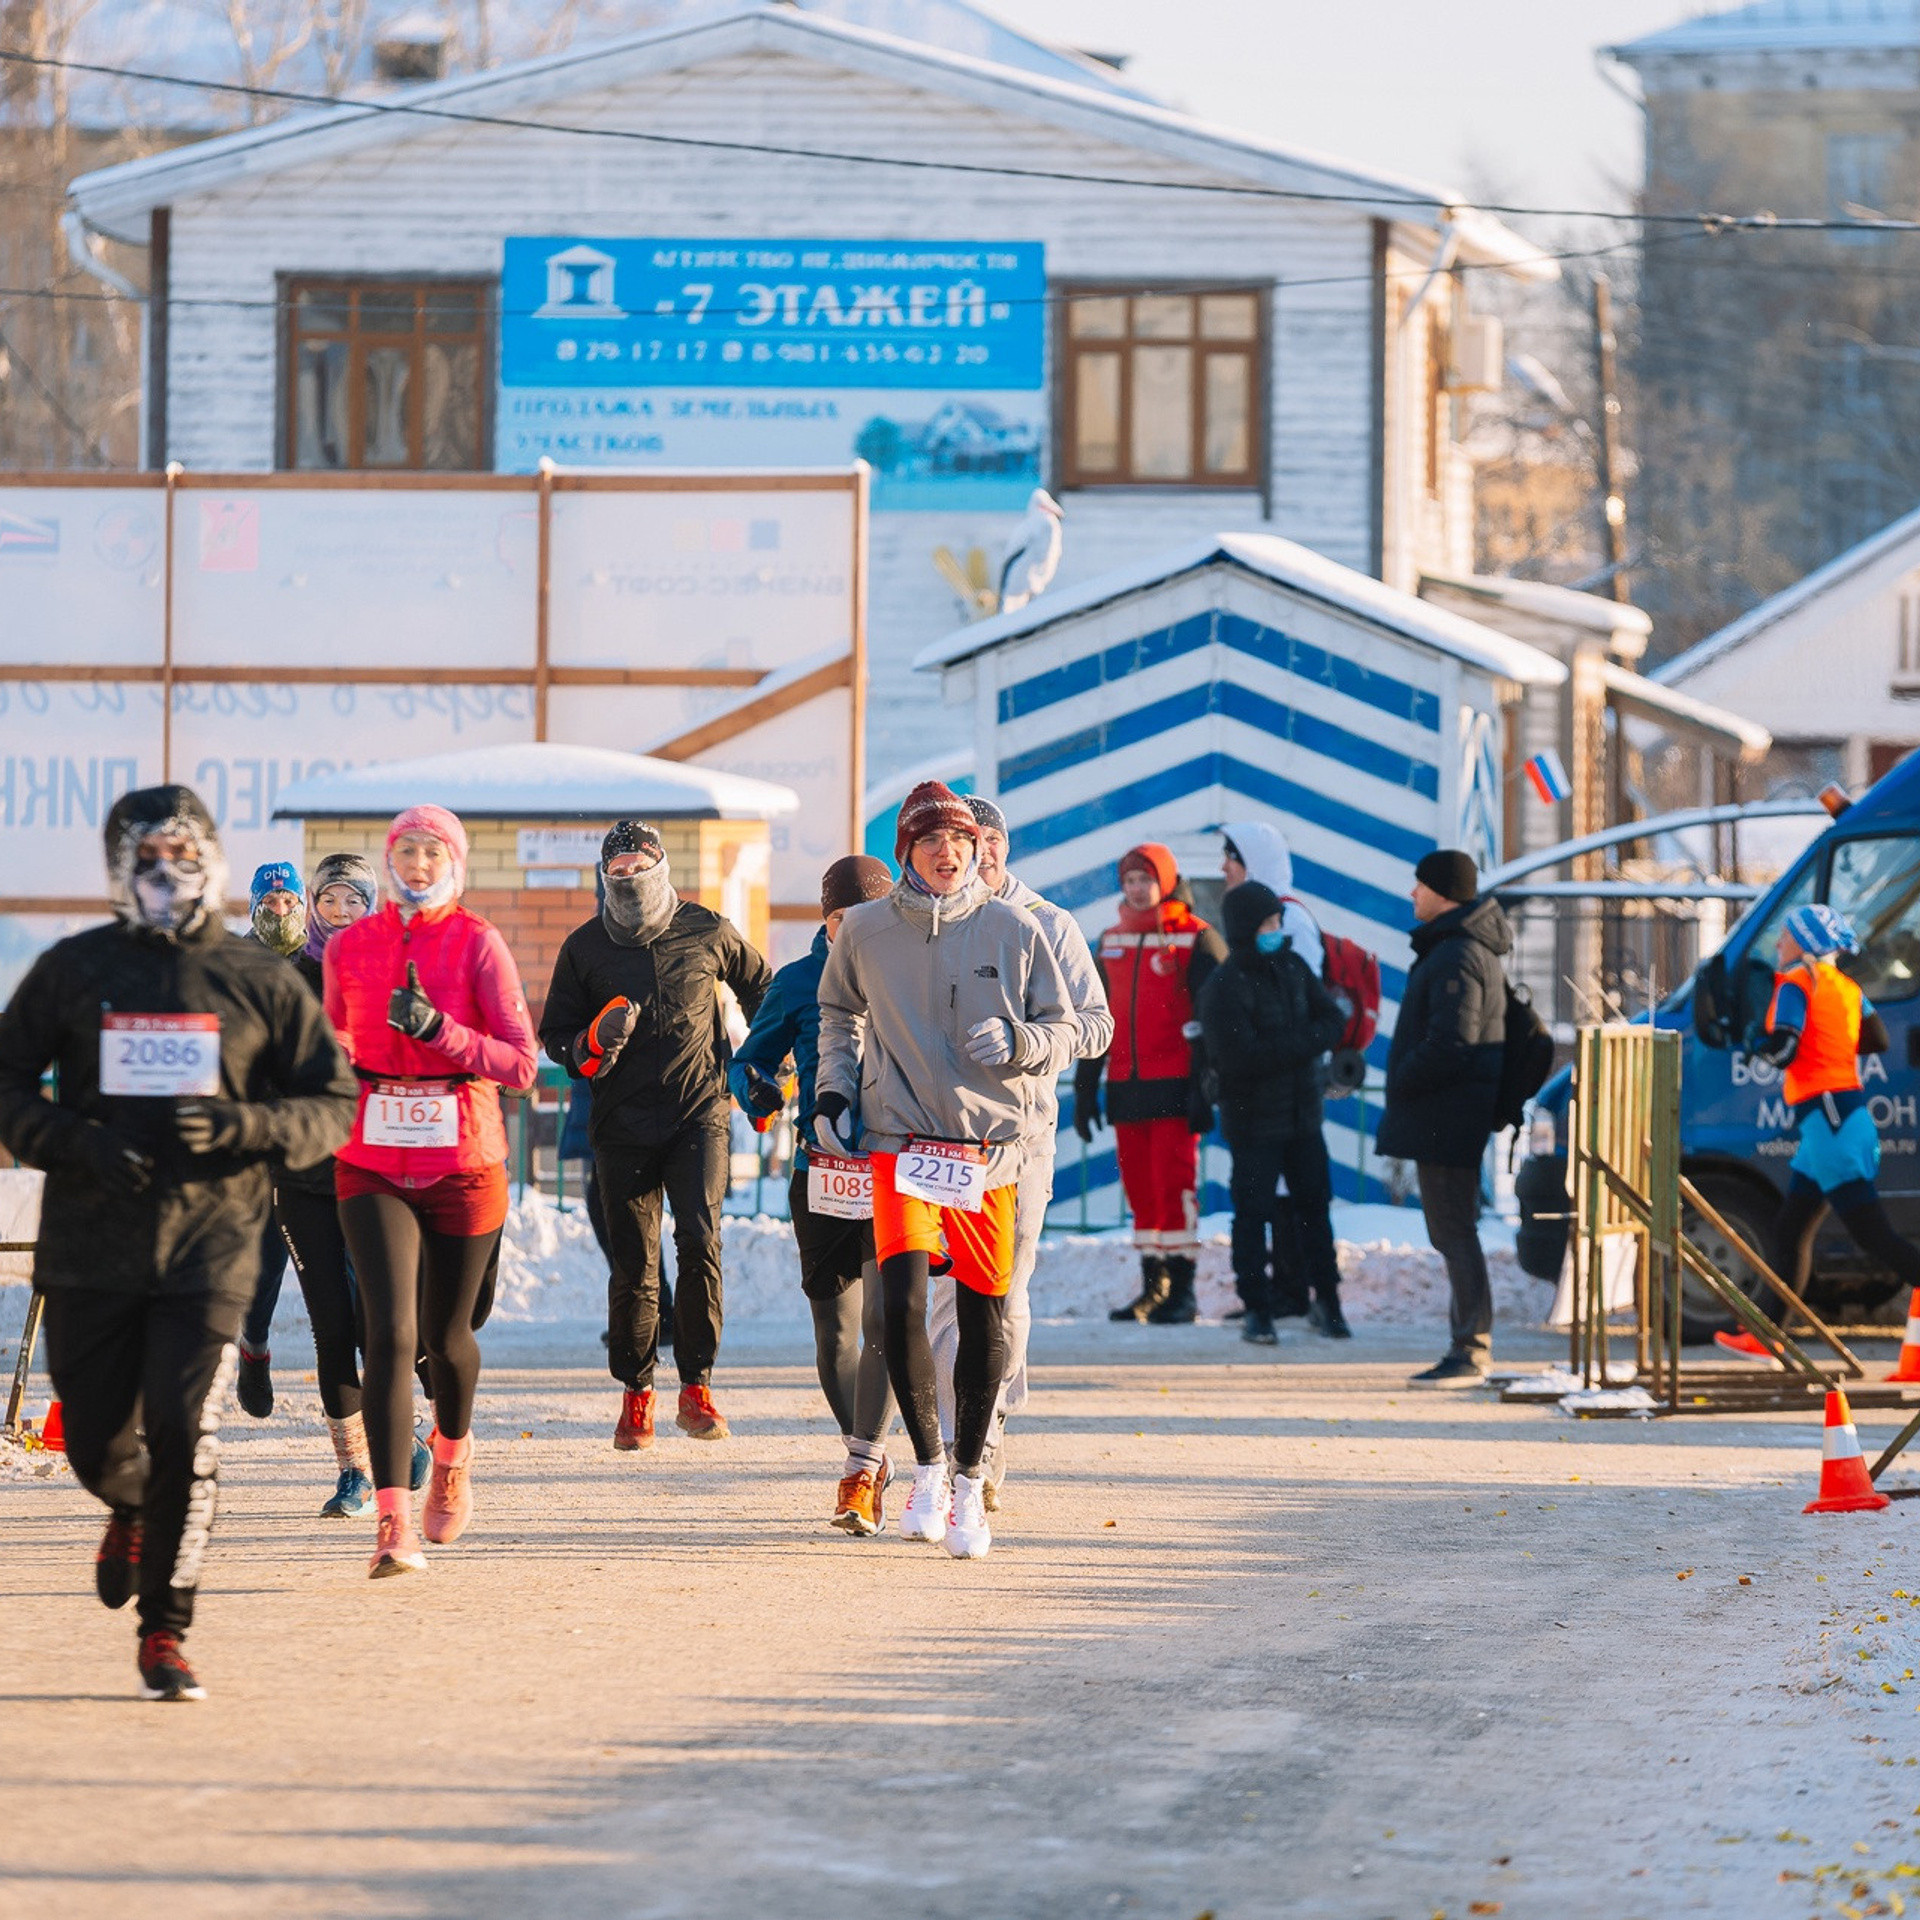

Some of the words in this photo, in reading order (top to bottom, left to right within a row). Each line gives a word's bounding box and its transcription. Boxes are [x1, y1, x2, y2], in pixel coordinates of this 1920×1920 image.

[119, 1036, 202, 1066] 2086
[379, 1099, 443, 1124] 1162
[833, 1159, 846, 1170] 10
[908, 1156, 974, 1187] 2215
[820, 1172, 874, 1198] 1089
